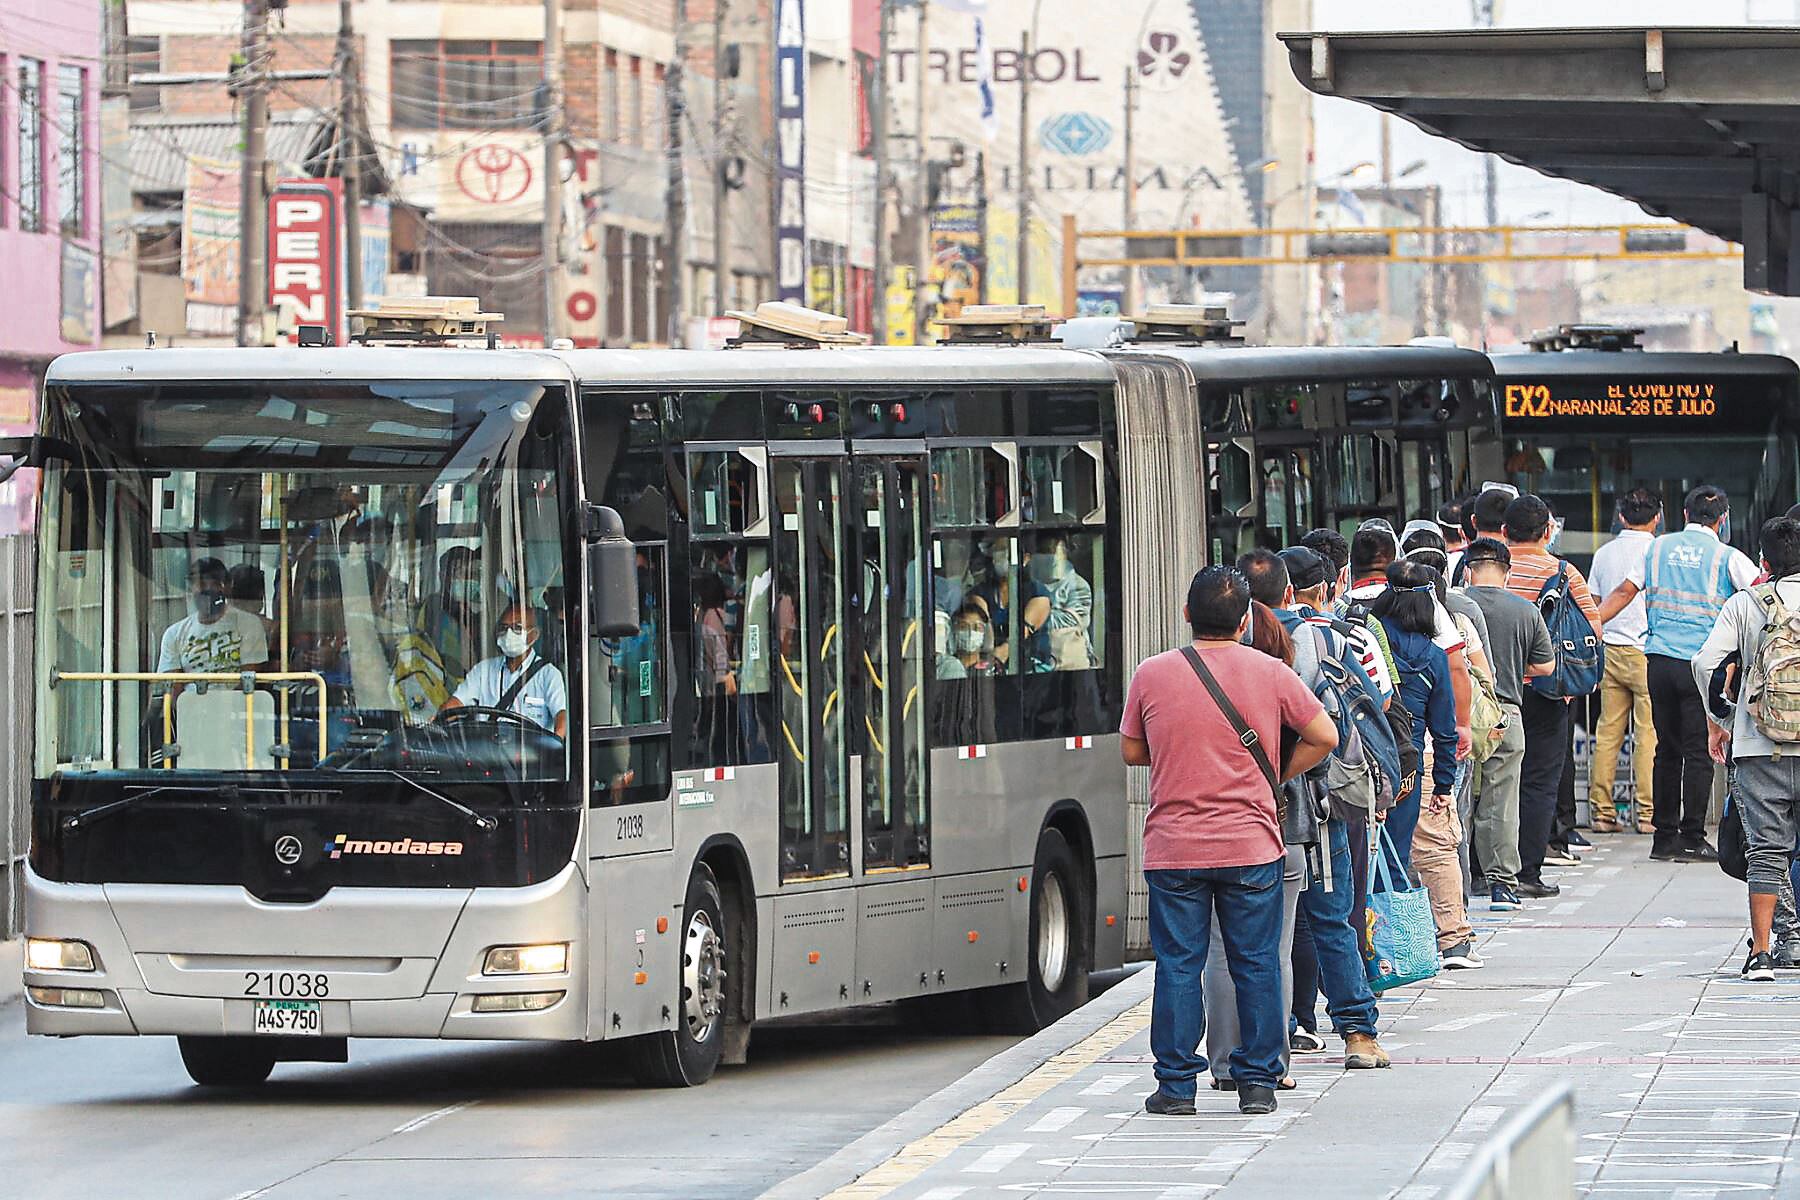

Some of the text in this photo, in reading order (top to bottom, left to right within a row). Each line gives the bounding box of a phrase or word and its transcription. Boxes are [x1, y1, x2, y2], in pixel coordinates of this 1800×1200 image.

[891, 48, 1101, 83] TREBOL
[1505, 384, 1551, 417] EX2
[1550, 399, 1716, 416] NARANJAL-28 DE JULIO
[616, 814, 644, 840] 21038
[343, 837, 463, 855] modasa
[244, 972, 329, 998] 21038
[258, 1009, 318, 1029] A4S-750
